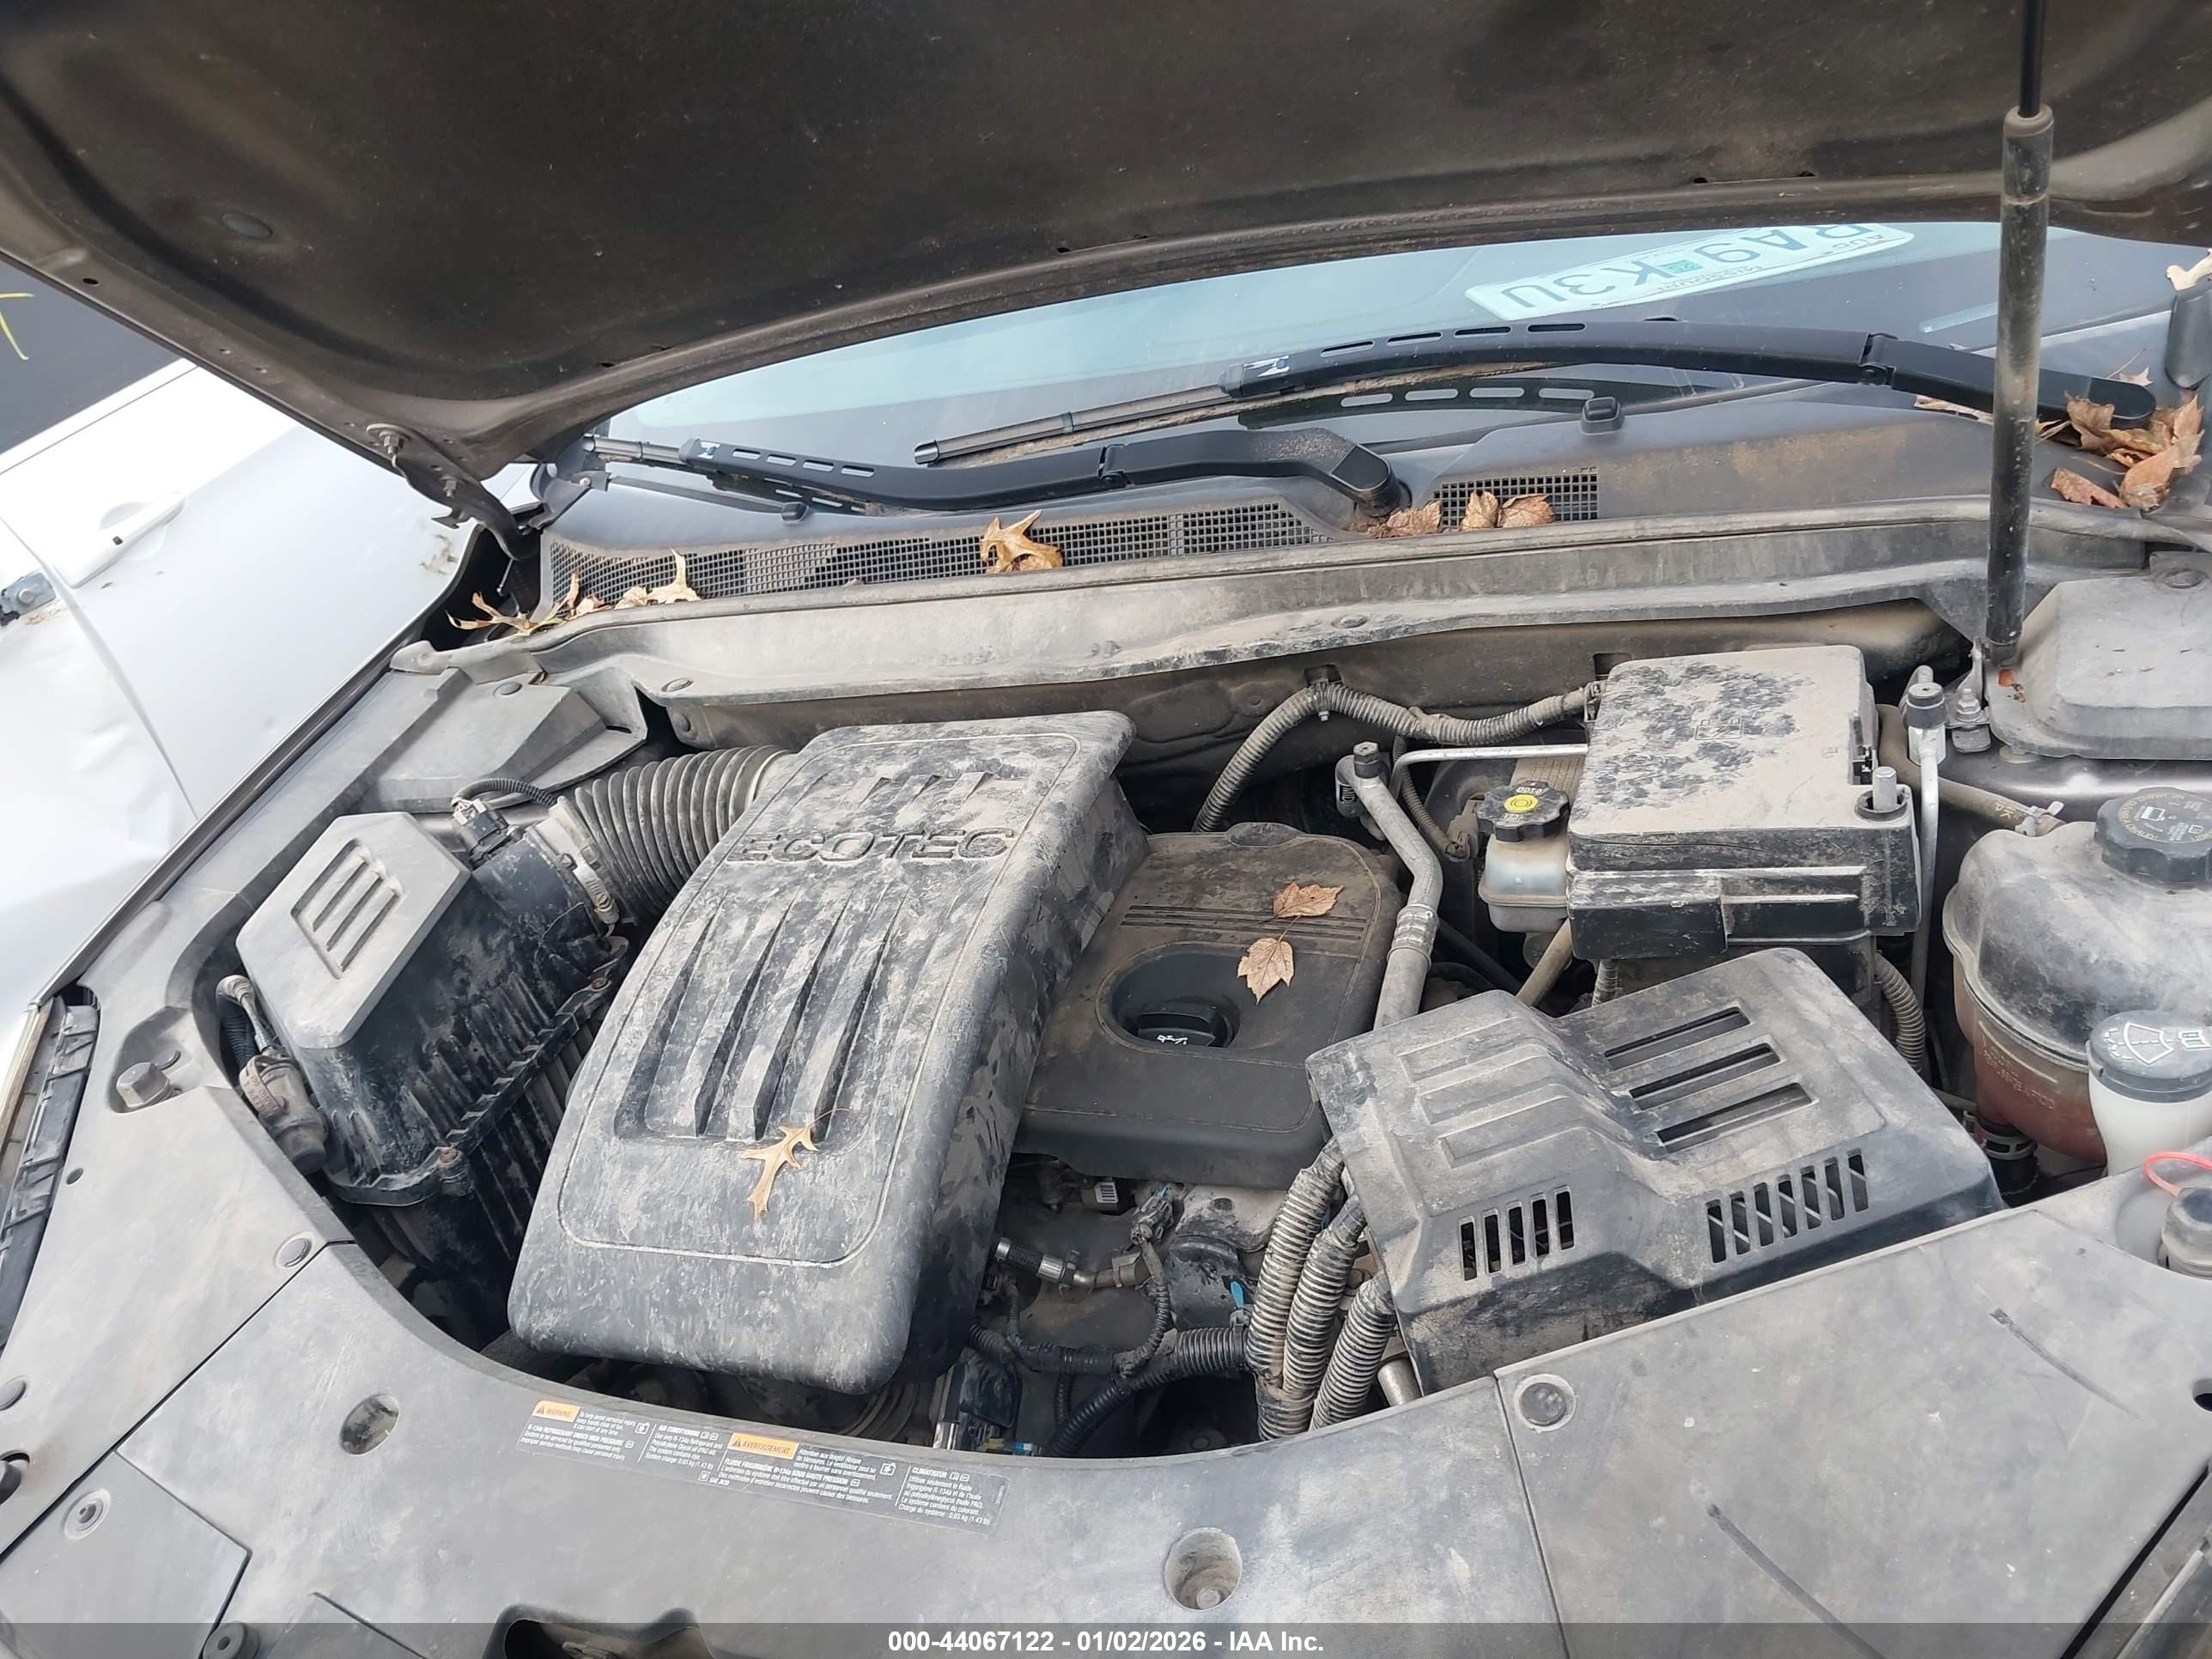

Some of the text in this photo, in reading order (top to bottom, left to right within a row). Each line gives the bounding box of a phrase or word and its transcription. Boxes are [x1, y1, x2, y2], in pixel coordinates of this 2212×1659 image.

[1500, 258, 1677, 308] K3U
[726, 827, 1015, 861] ECOTEC
[741, 1441, 790, 1455] AVERTISSEMENT
